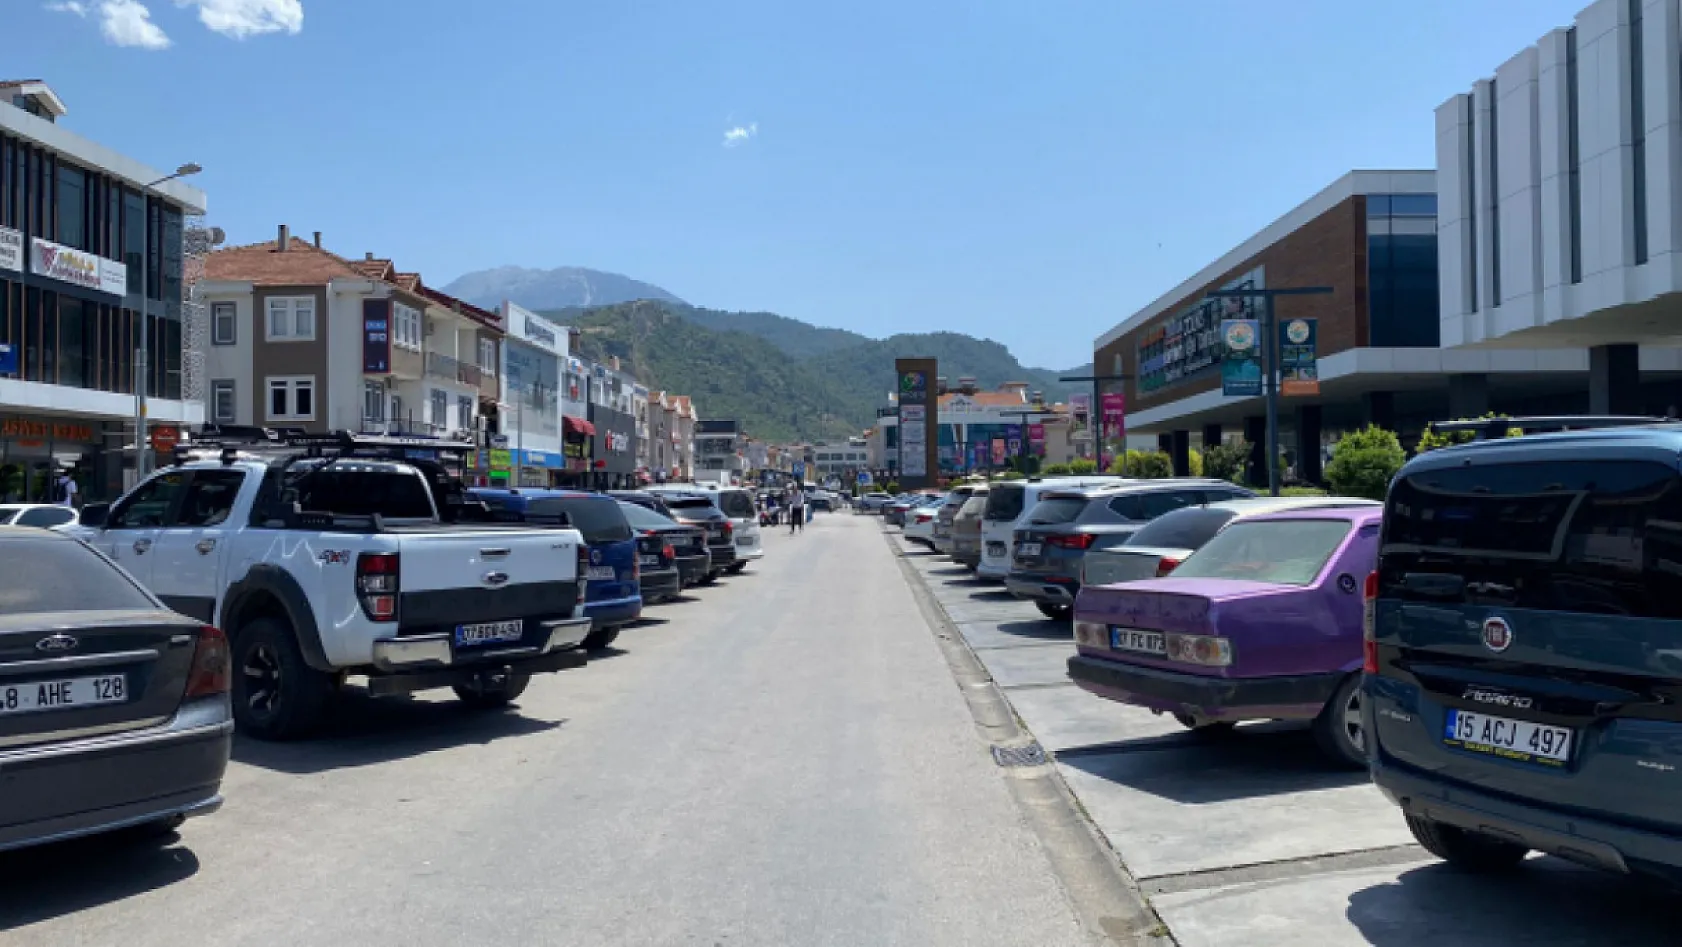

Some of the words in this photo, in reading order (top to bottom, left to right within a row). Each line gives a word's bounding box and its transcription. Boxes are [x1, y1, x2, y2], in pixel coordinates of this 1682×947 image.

[37, 681, 73, 706] AHE
[92, 677, 124, 699] 128
[1456, 714, 1475, 738] 15
[1481, 717, 1517, 748] ACJ
[1528, 727, 1567, 757] 497
